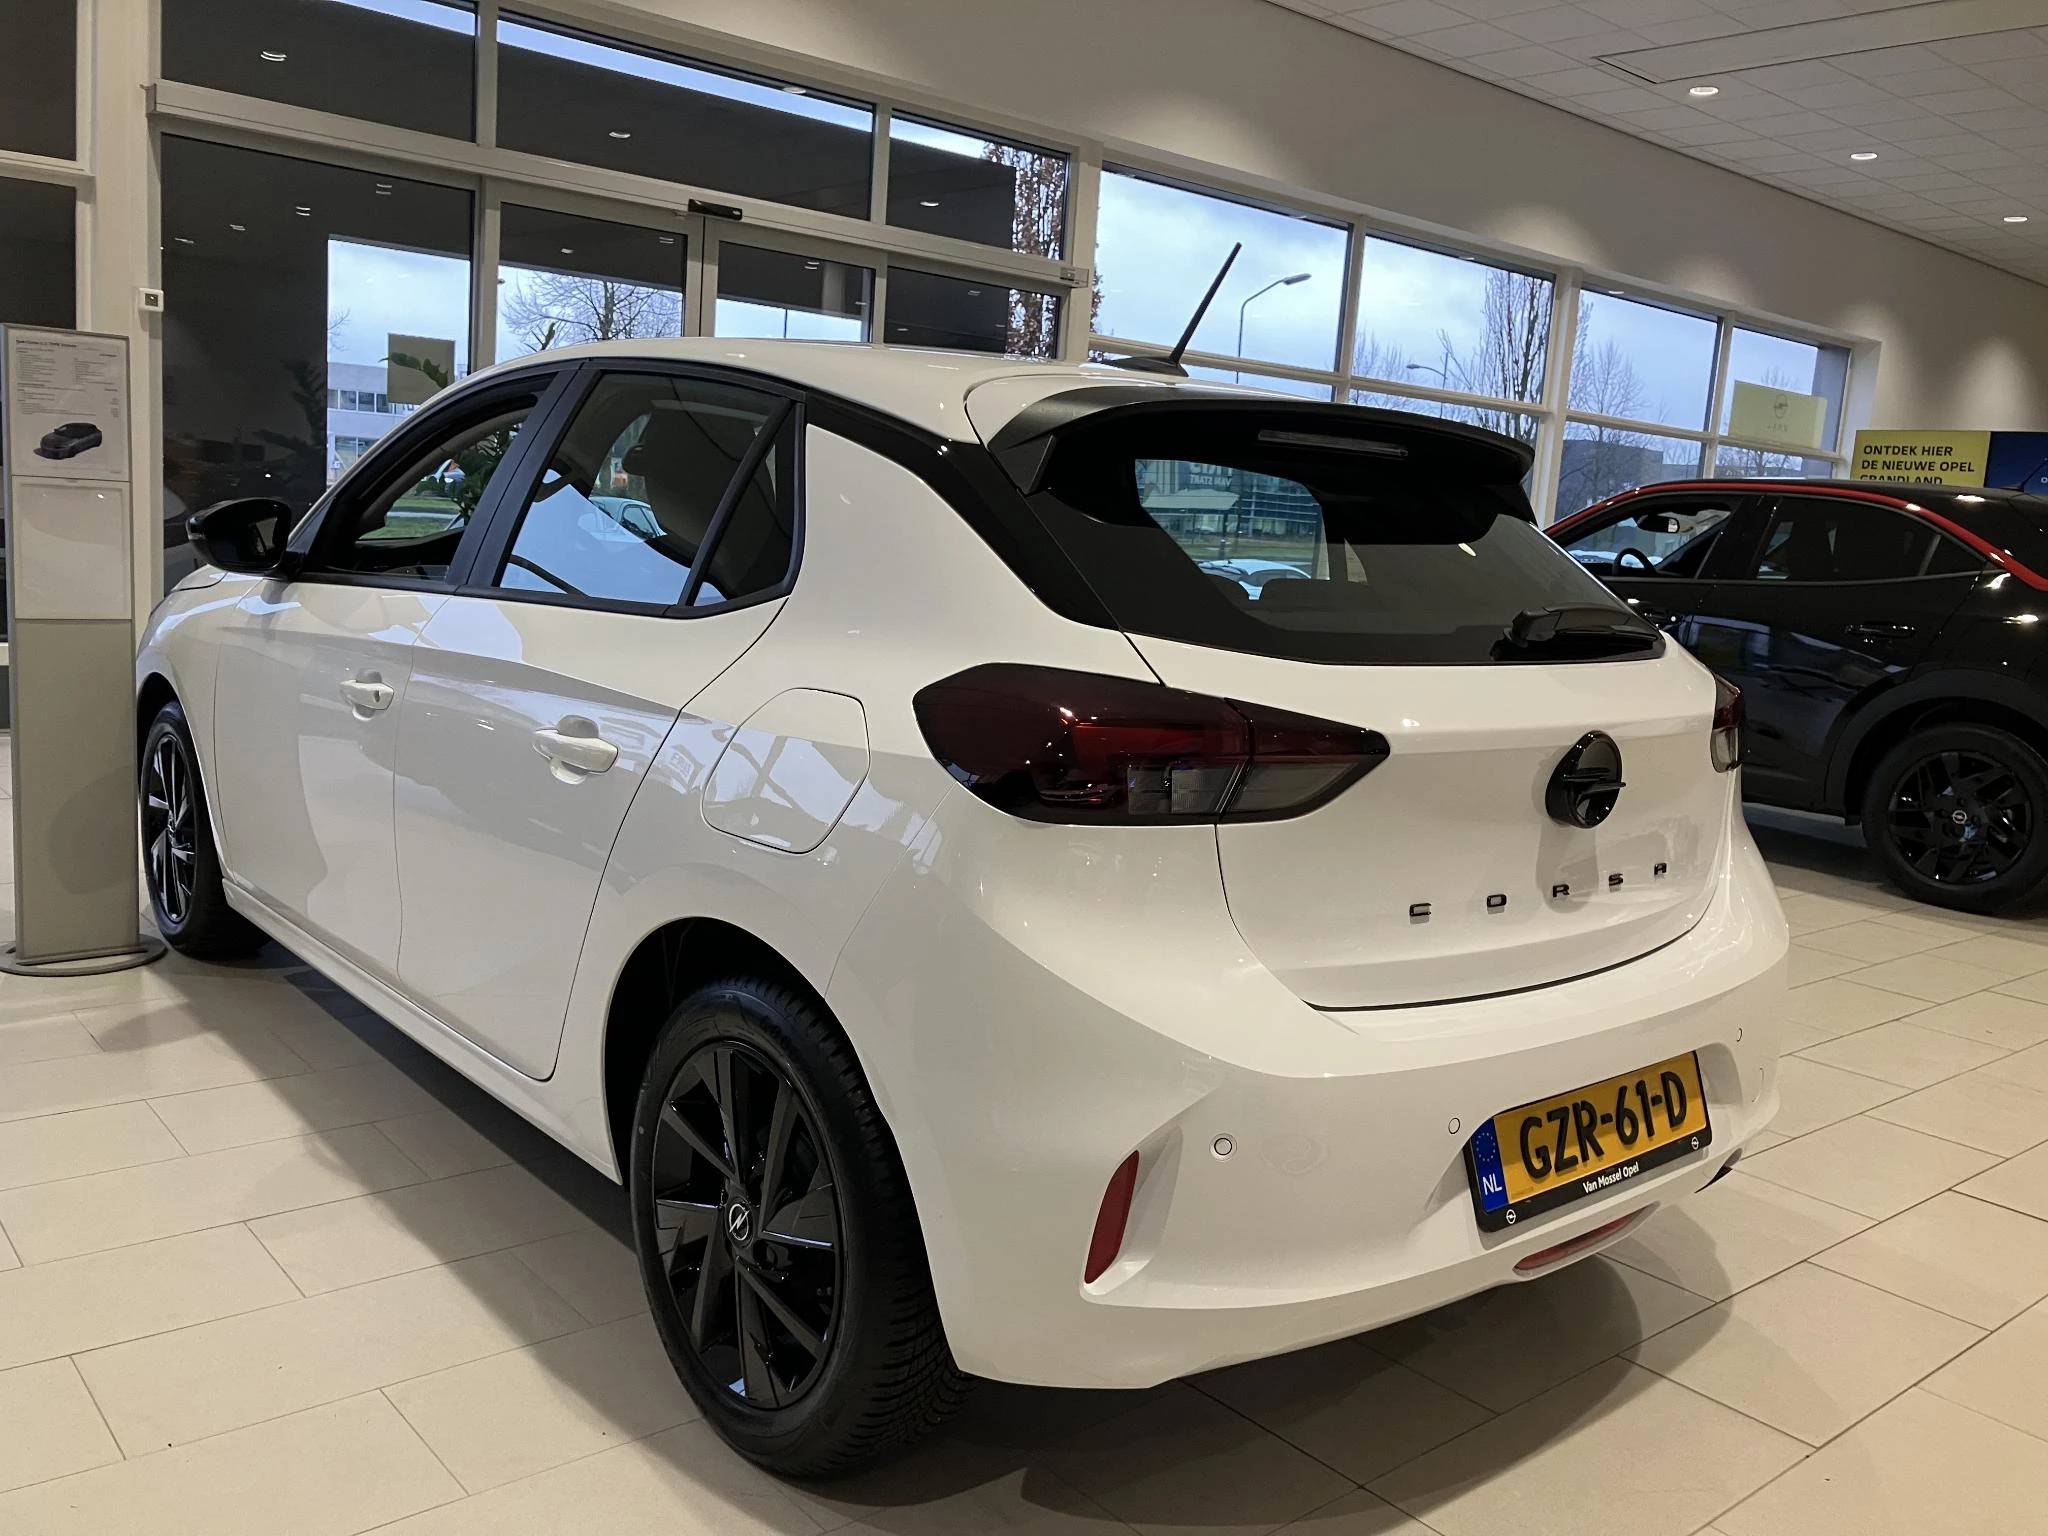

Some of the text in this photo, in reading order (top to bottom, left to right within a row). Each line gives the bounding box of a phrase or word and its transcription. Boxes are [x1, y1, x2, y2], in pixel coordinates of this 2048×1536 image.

[1863, 445, 1953, 457] ONTDEK HIER
[1861, 460, 1975, 472] DE NIEUWE OPEL
[1409, 862, 1667, 917] CORSA
[1519, 1070, 1688, 1180] GZR-61-D
[1482, 1173, 1503, 1196] NL
[1582, 1161, 1640, 1194] Van Mossel Opel
